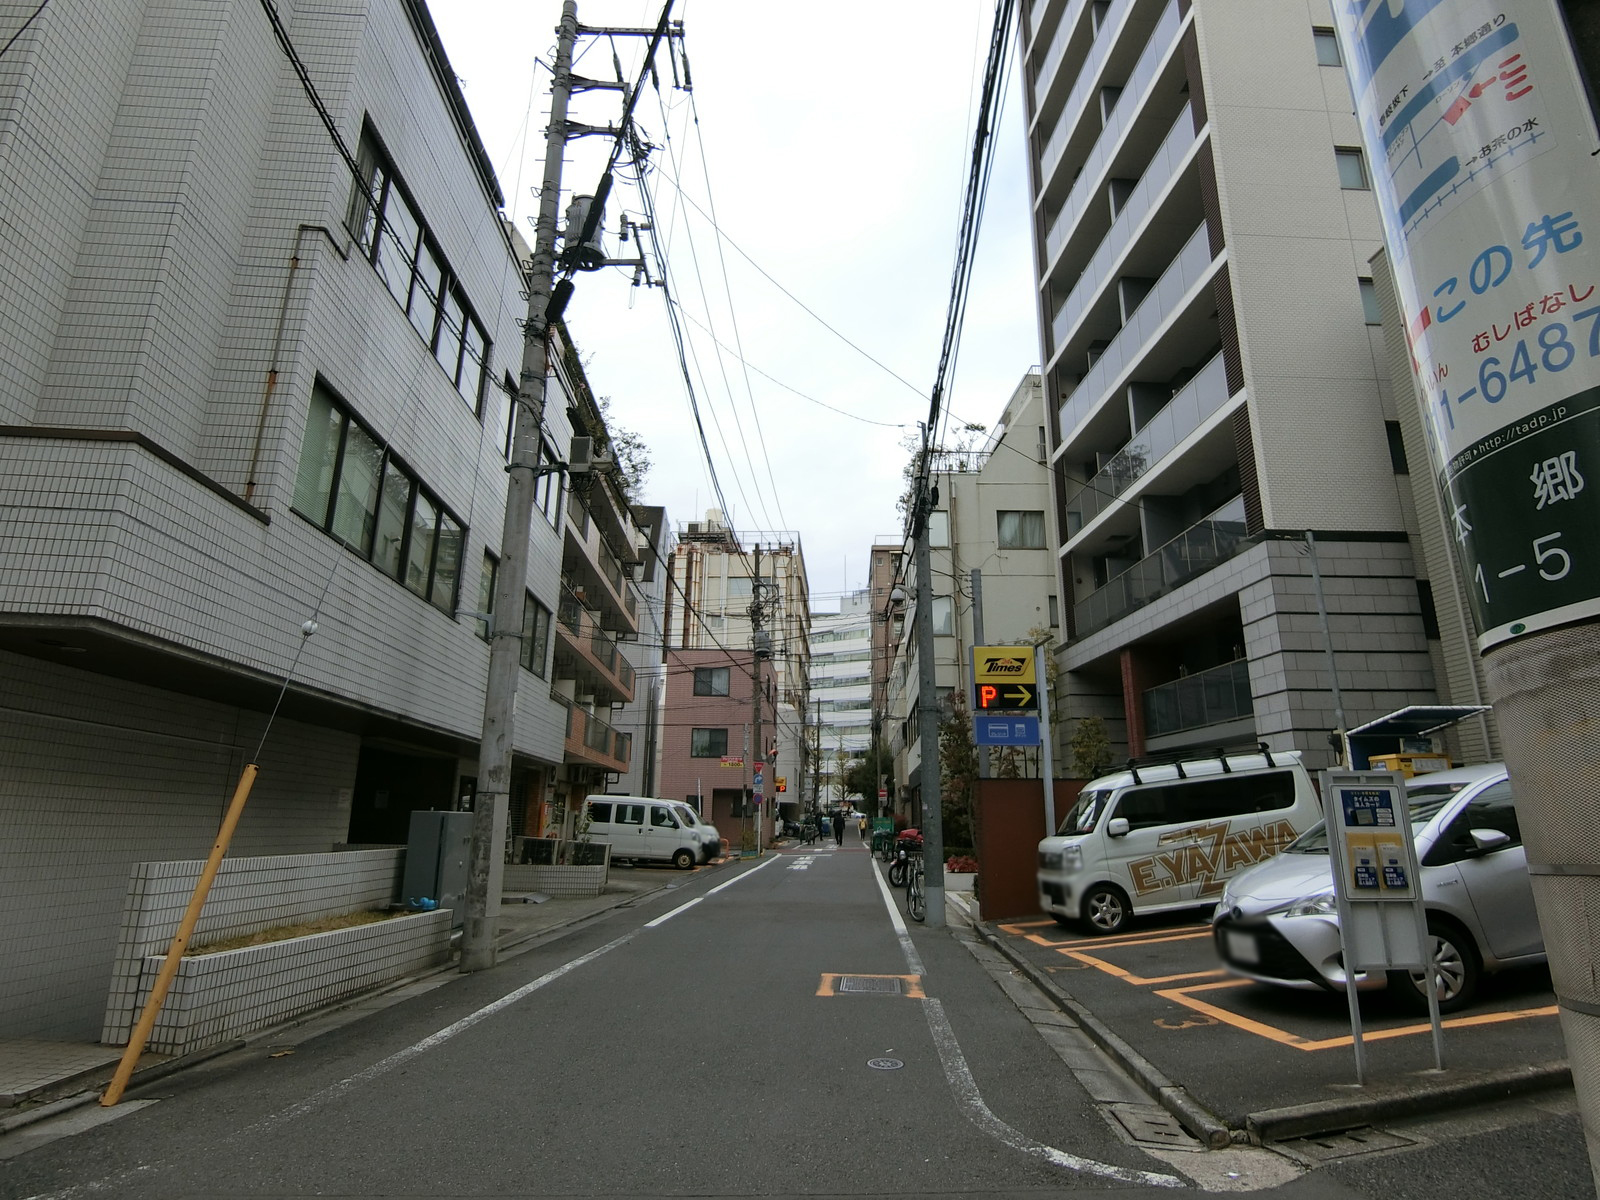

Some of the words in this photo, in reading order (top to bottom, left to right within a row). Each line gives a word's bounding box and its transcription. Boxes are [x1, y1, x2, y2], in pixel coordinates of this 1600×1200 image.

[1450, 13, 1507, 58] 本郷通り
[1478, 117, 1540, 160] お茶の水
[1433, 211, 1583, 323] この先
[984, 658, 1026, 673] Times
[981, 685, 997, 708] P
